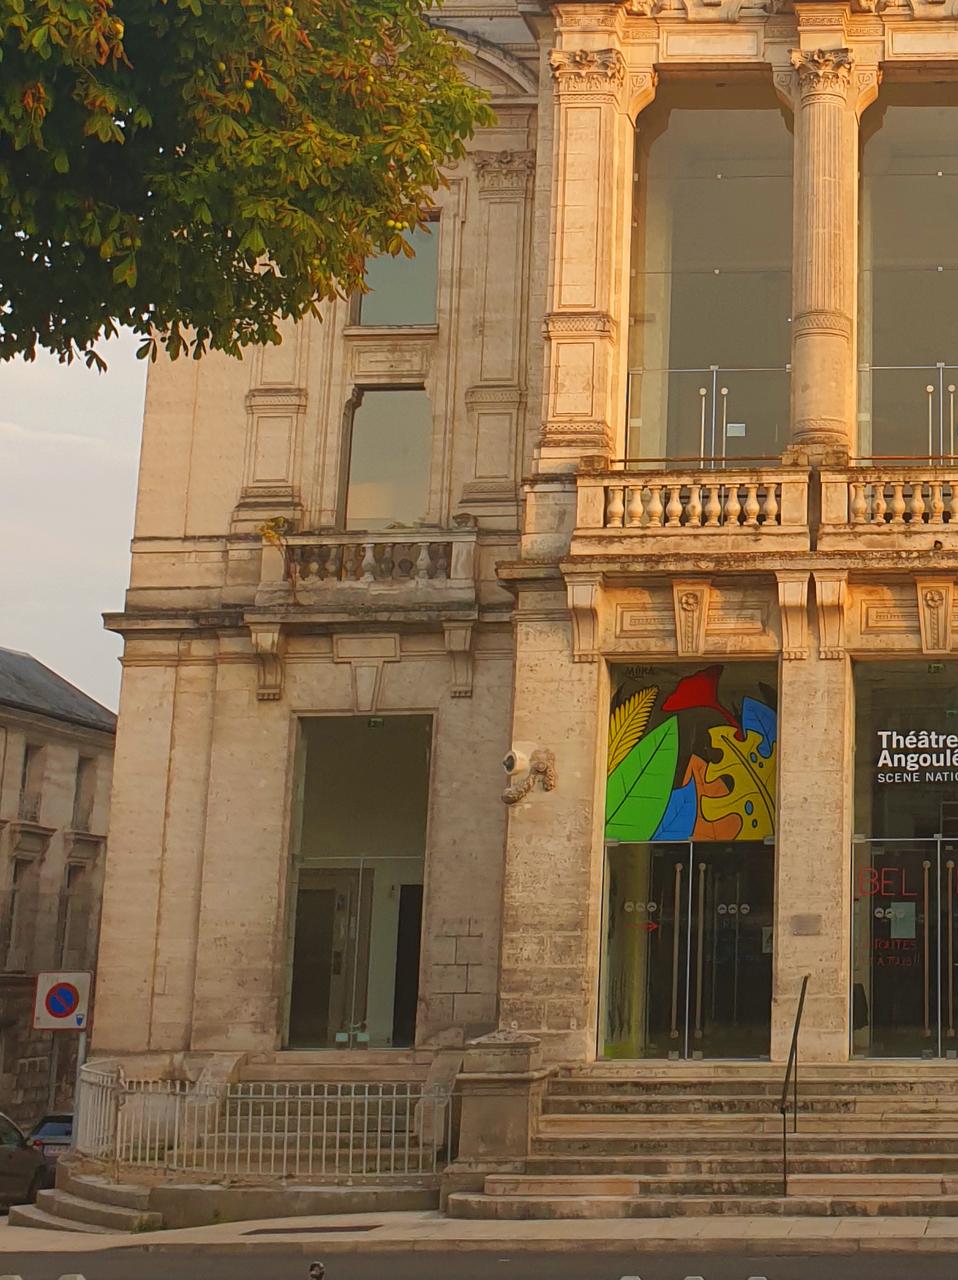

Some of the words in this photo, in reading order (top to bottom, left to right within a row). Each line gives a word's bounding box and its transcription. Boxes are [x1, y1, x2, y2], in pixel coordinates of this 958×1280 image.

[877, 730, 958, 749] Théâtre
[877, 772, 921, 783] SCENE
[859, 864, 918, 897] BEL
